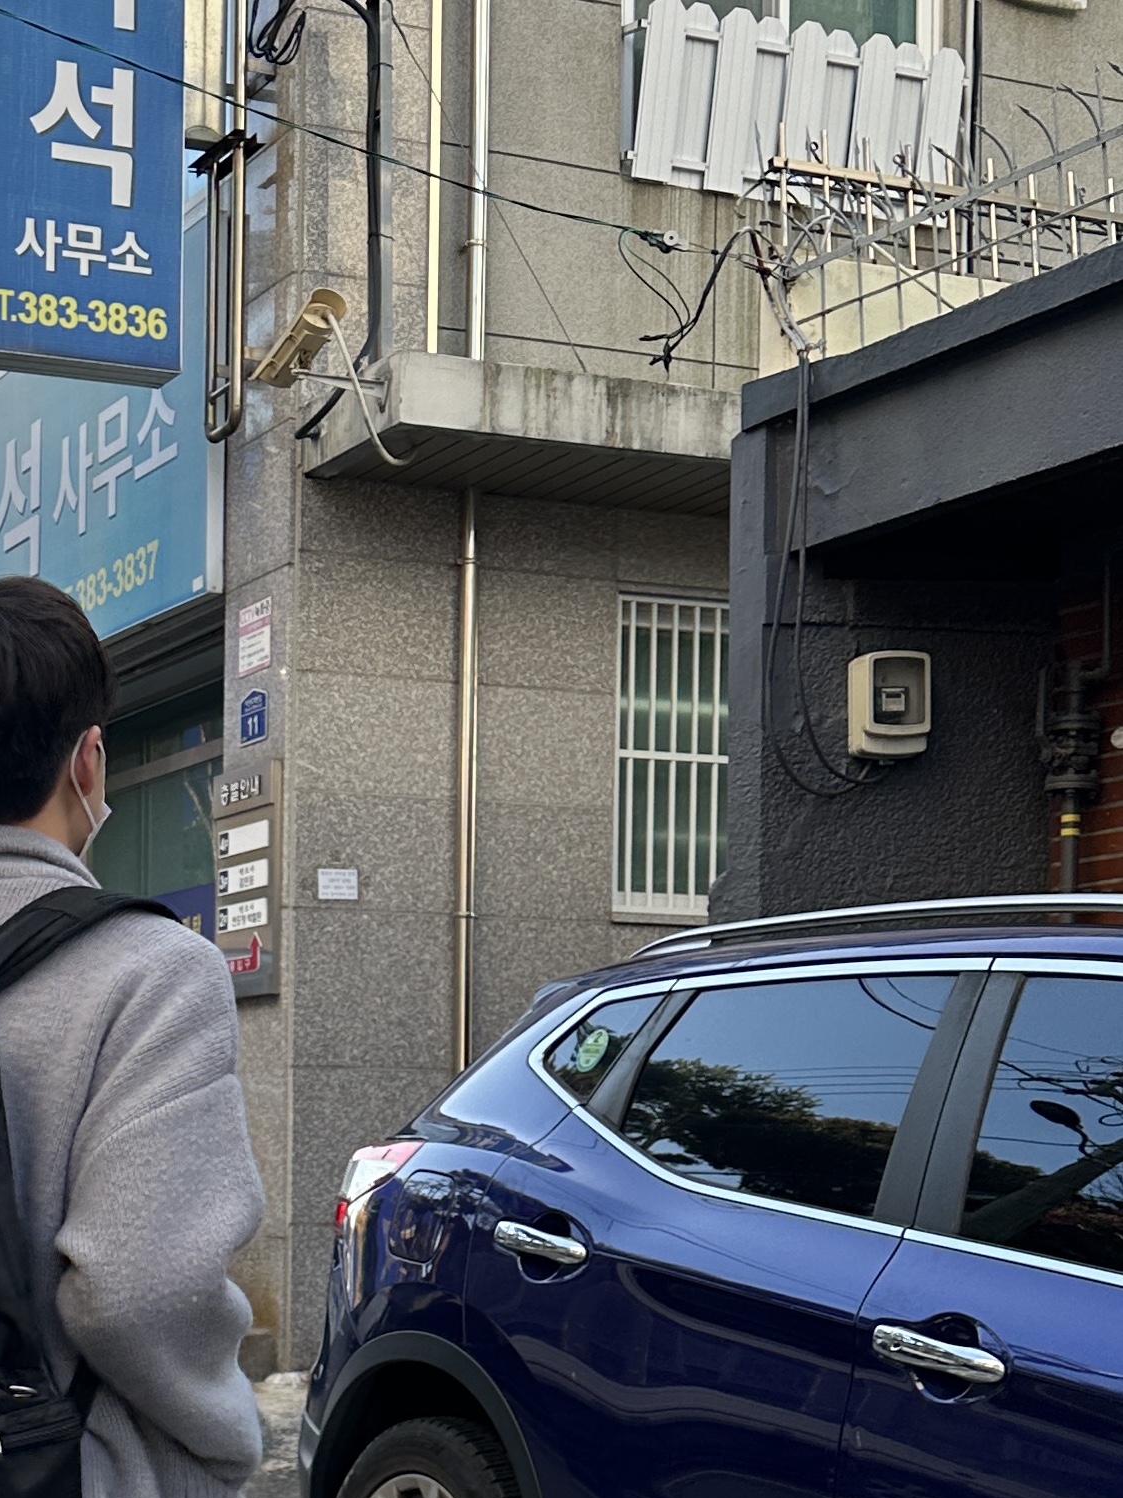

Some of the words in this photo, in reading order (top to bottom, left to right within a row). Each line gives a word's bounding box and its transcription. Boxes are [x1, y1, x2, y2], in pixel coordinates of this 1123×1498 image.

[14, 216, 153, 277] 사무소
[51, 388, 179, 537] 사무소
[63, 539, 160, 612] 383-3837
[247, 714, 260, 737] 11
[220, 774, 261, 807] 층별안내
